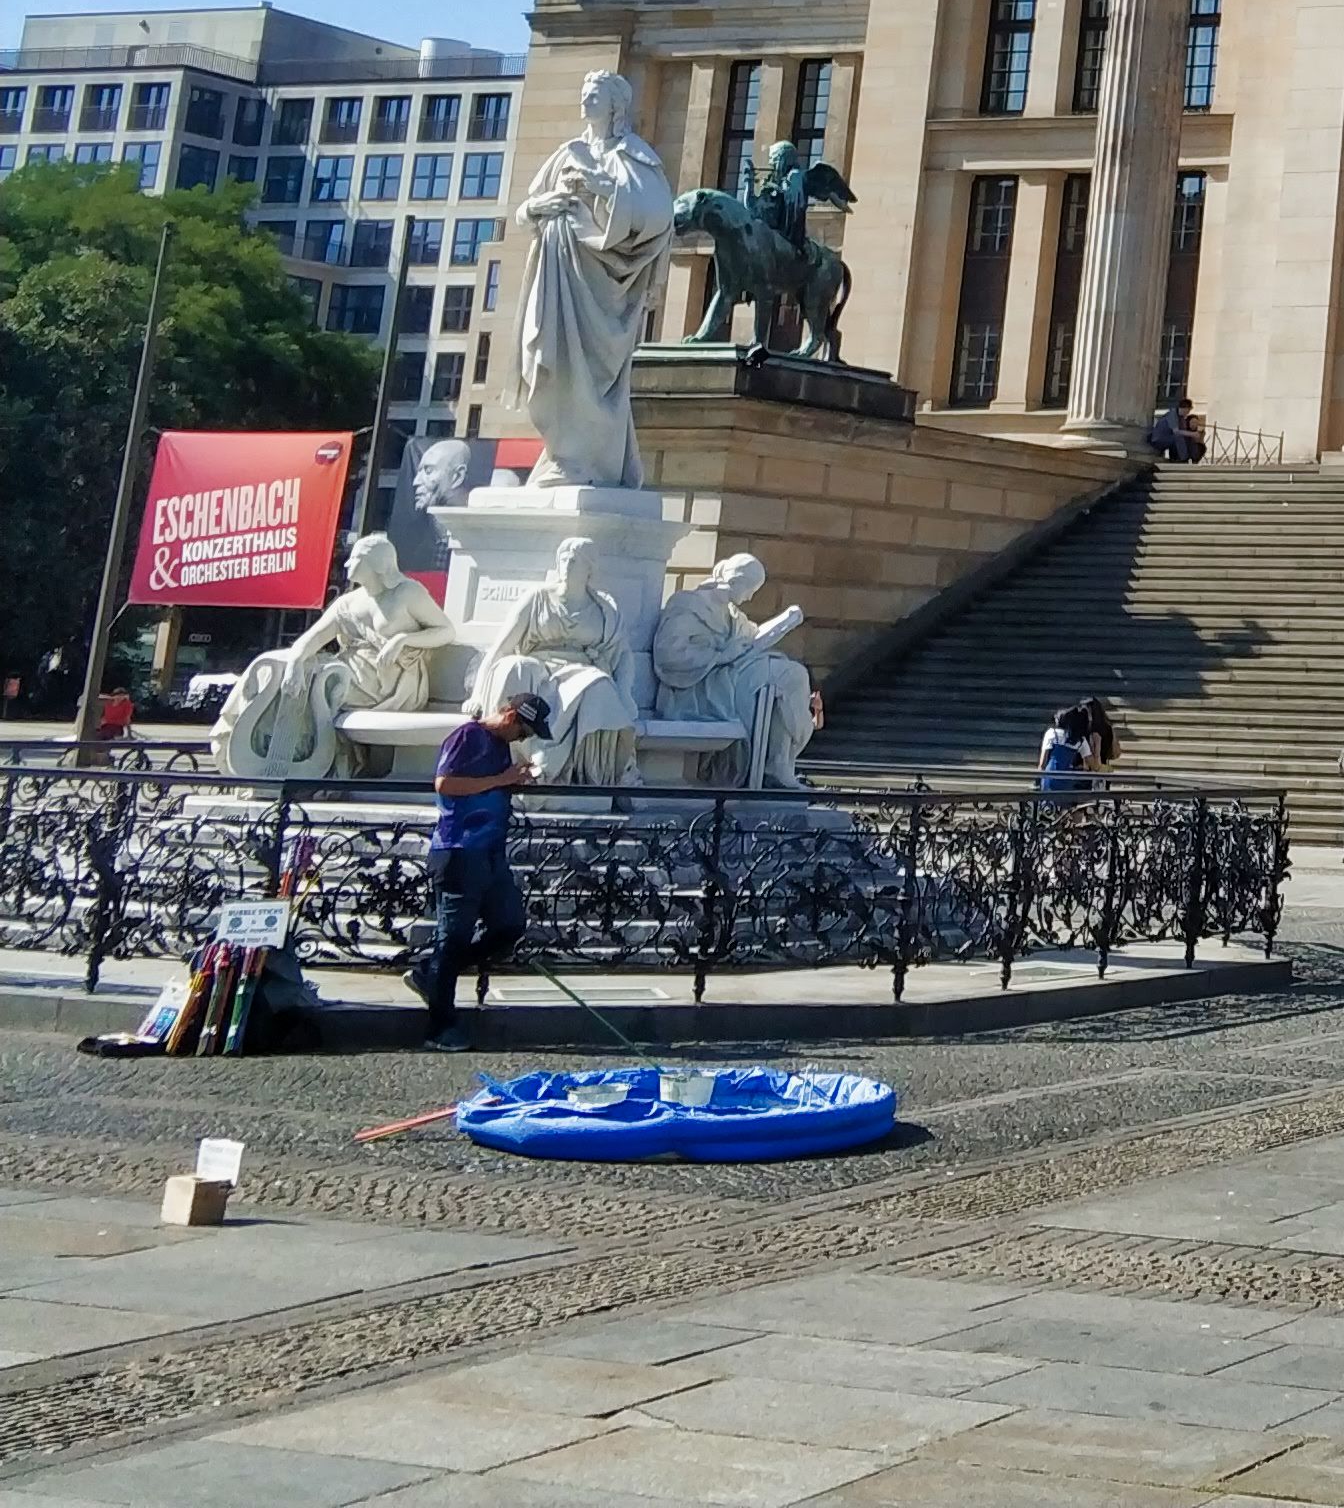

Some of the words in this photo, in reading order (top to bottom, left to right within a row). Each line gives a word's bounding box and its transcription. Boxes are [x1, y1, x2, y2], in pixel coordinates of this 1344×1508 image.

[153, 478, 301, 544] ESCHENBACH
[182, 527, 298, 563] KONZERTHAUS
[150, 547, 180, 590] &
[180, 556, 250, 587] ORCHESTER
[251, 550, 297, 577] BERLIN
